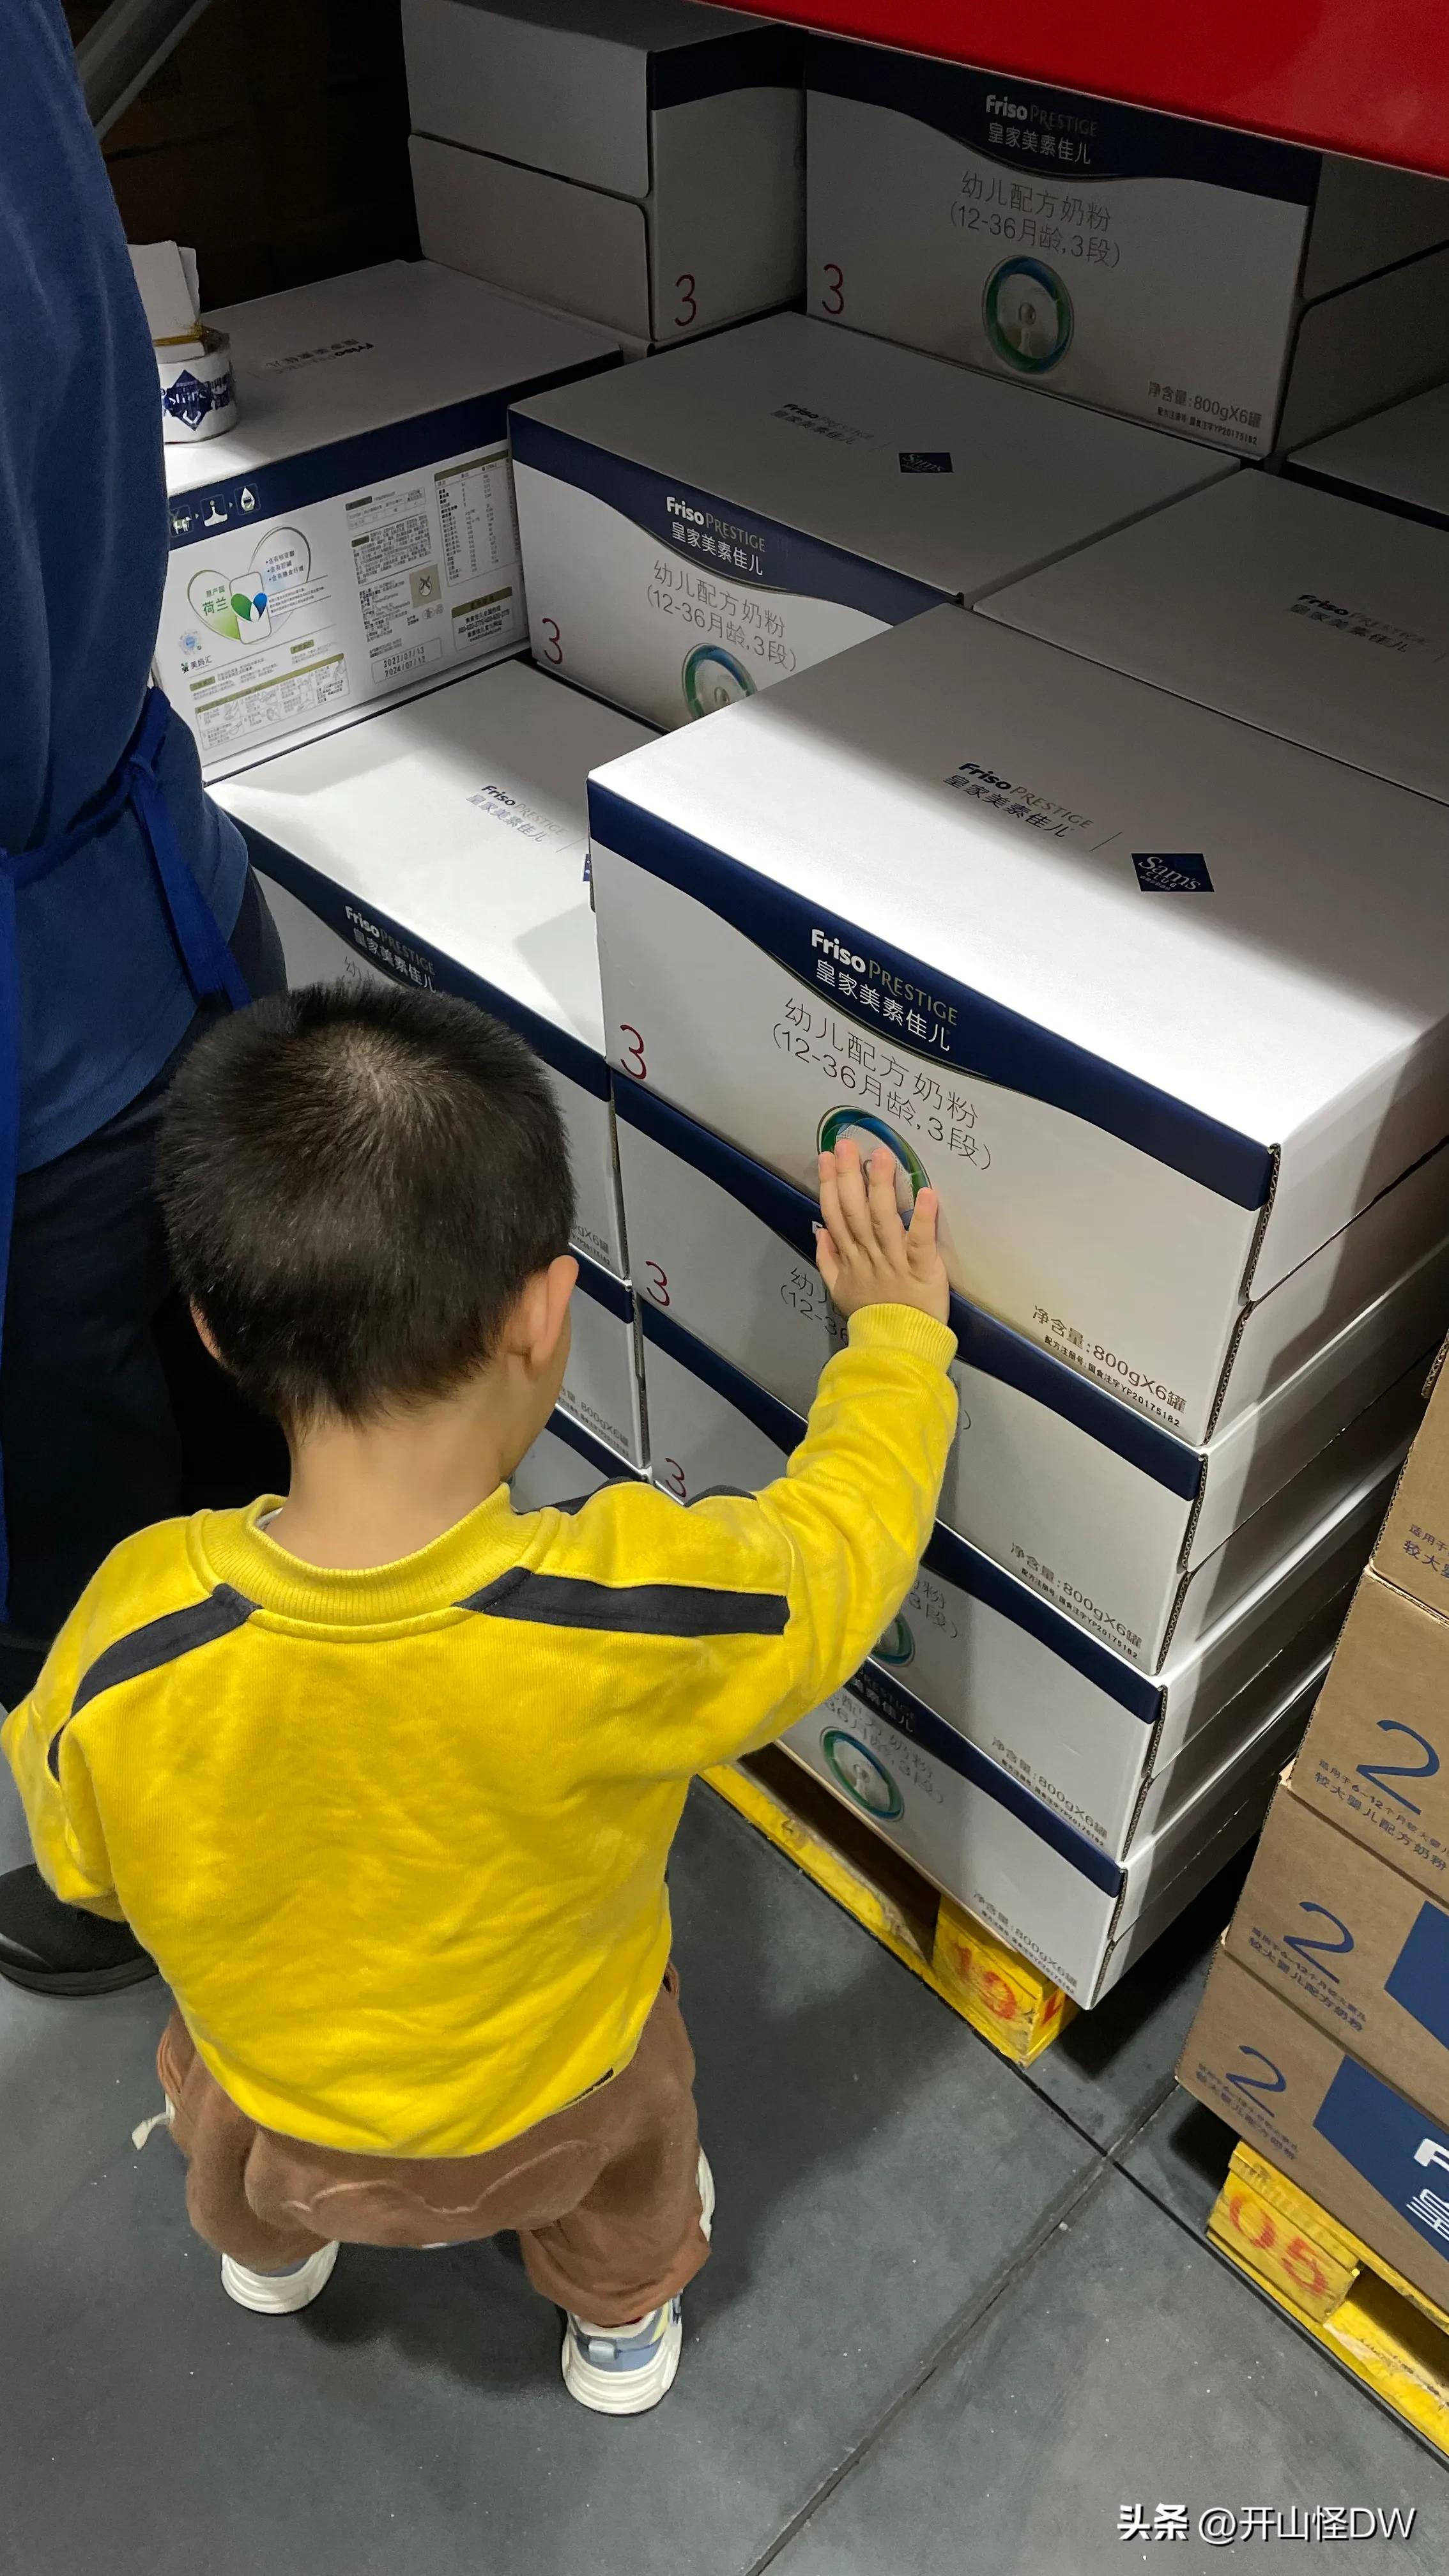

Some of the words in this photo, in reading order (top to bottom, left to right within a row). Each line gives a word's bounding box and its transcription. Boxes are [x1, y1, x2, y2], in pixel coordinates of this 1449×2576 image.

[986, 94, 1027, 121] Friso
[987, 122, 1091, 165] 皇家美素佳儿
[960, 171, 1111, 233] 幼儿配方奶粉
[950, 200, 1121, 269] (12-36月龄,3段)
[675, 275, 697, 327] 3
[822, 264, 845, 315] 3
[666, 496, 705, 526] Friso
[705, 513, 767, 553] PRESTIGE
[671, 521, 763, 577] 皇家美素佳儿
[202, 597, 229, 617] 荷兰
[654, 559, 786, 638] 幼儿配方奶粉
[541, 618, 564, 665] 3
[647, 586, 797, 673] (12-36月龄,3段)
[465, 793, 548, 843] 皇家美素佳儿
[480, 785, 516, 807] Friso
[942, 774, 1071, 839] 皇家美素佳儿
[958, 762, 1012, 791] Friso
[1010, 785, 1094, 830] PRESTIGE
[1137, 856, 1202, 890] Sam's
[345, 905, 380, 938] Friso
[811, 928, 866, 974] Friso
[867, 960, 958, 1027] PRESTIGE
[816, 959, 951, 1053] 皇家美素佳儿
[620, 1025, 648, 1080] 3
[784, 997, 979, 1130] 幼儿配方奶粉
[772, 1022, 992, 1171] (12-36月龄,3段)
[645, 1261, 671, 1307] 3
[1032, 1304, 1188, 1415] 净含量:800gX6罐
[666, 1457, 687, 1498] 3
[1409, 1524, 1449, 1556] 适用于
[1009, 1540, 1143, 1649] 净含量:800gX6罐
[1356, 1719, 1440, 1816] 2
[1315, 1772, 1447, 1871] 较大婴儿配方奶粉
[1284, 1901, 1354, 1984] 2
[1225, 2045, 1287, 2118] 2
